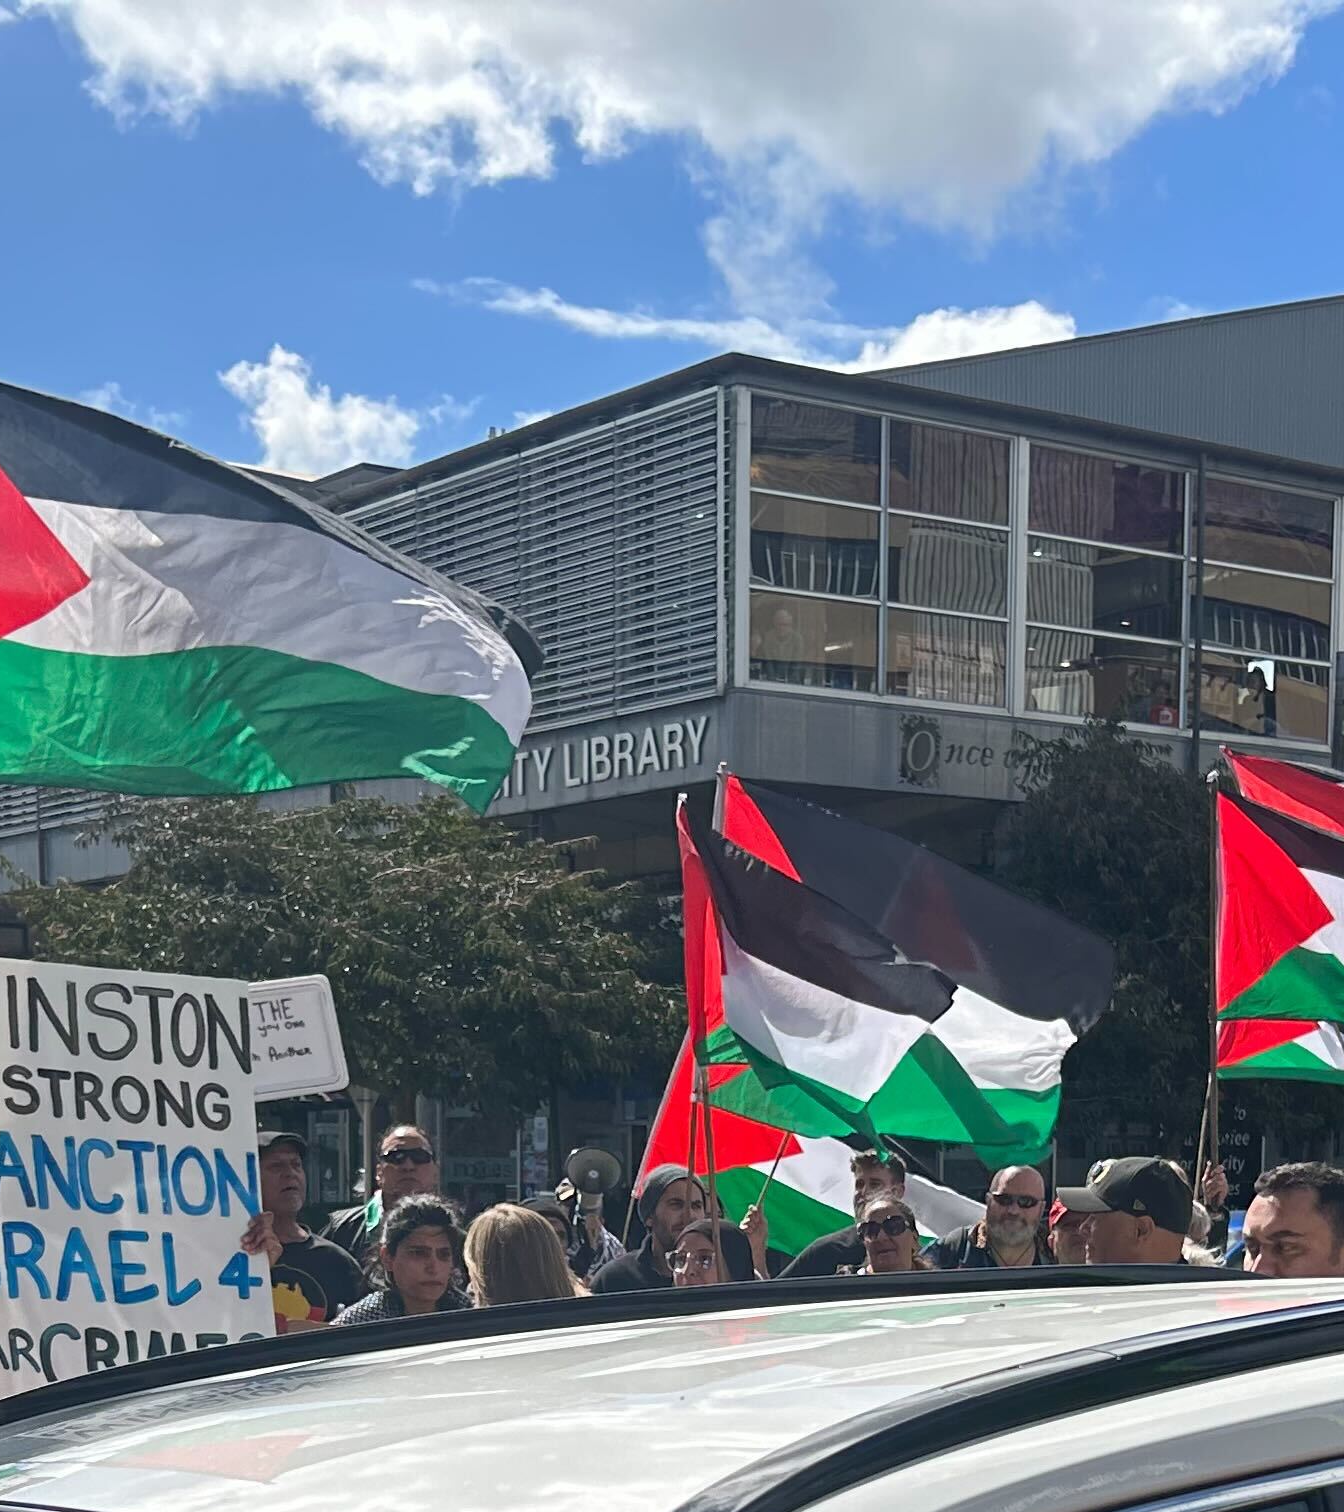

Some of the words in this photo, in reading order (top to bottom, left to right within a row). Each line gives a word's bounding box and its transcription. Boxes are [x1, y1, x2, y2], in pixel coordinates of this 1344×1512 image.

[494, 746, 554, 801] ITY
[562, 715, 708, 788] LIBRARY
[252, 997, 295, 1023] THE
[3, 1063, 232, 1131] STRONG
[218, 1252, 263, 1300] 4
[40, 1323, 266, 1383] CRIME
